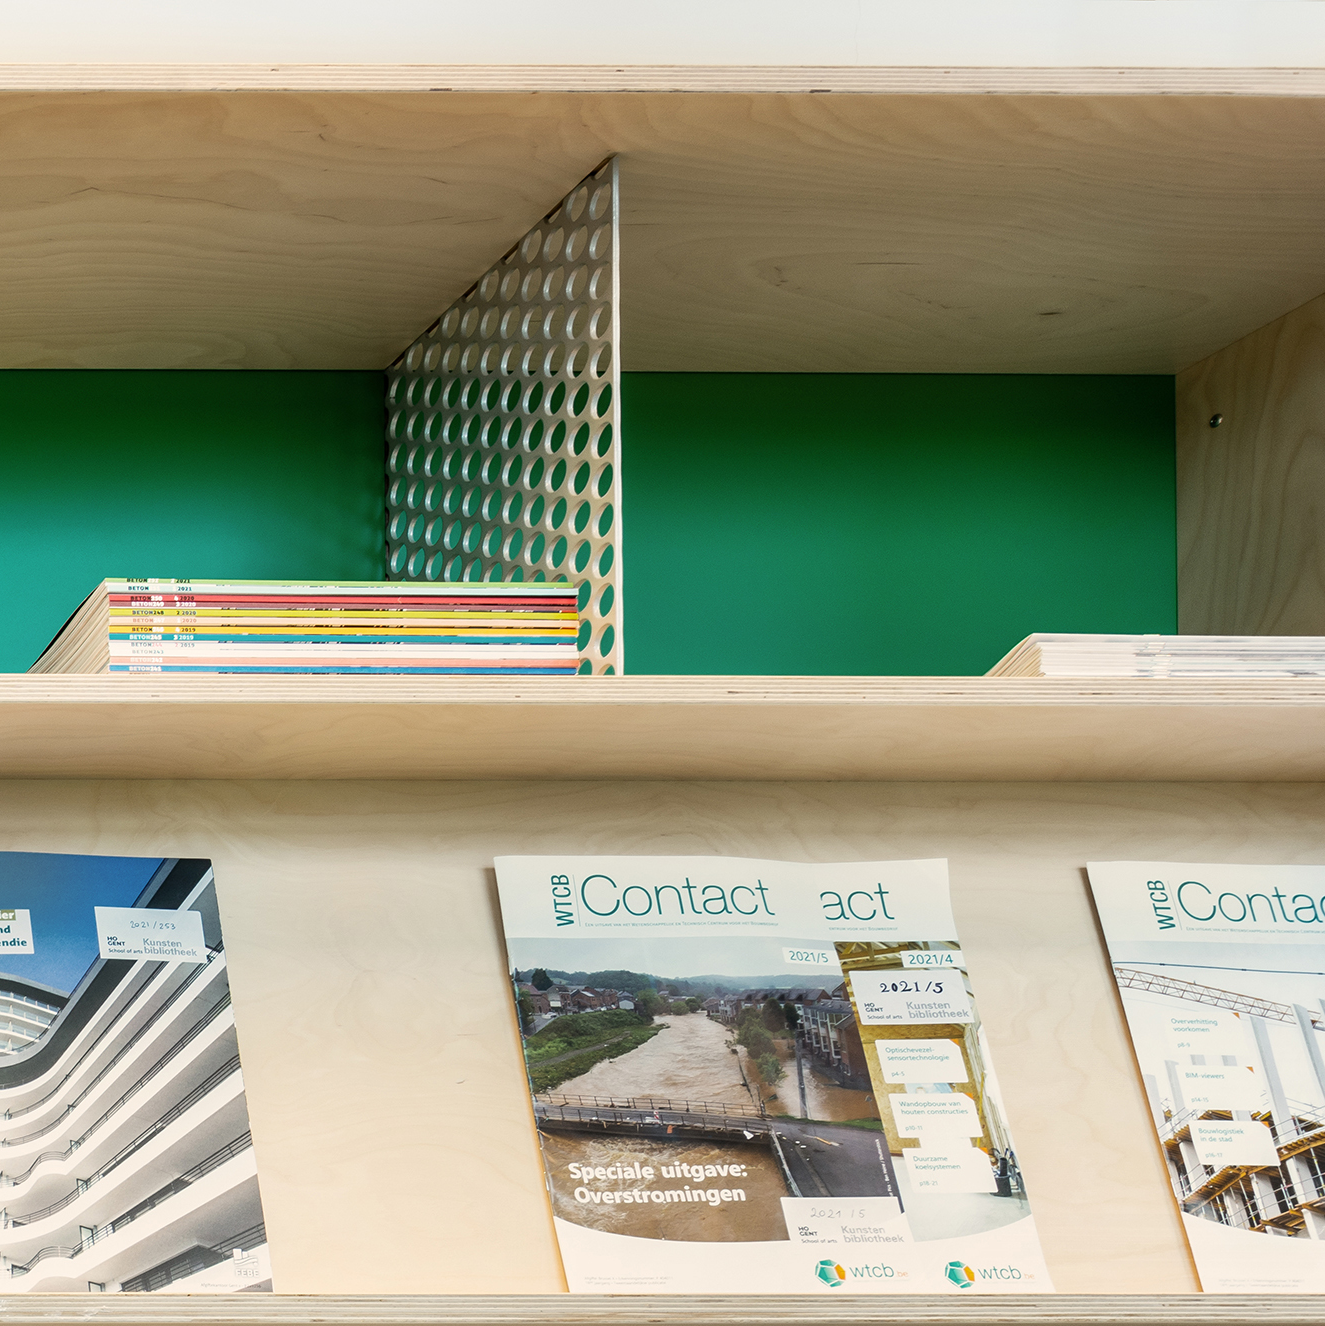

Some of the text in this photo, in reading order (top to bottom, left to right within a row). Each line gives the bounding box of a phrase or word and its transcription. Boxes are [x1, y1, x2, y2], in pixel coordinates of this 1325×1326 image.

[551, 874, 574, 926] WTCB
[581, 874, 775, 916] Contact
[1147, 880, 1176, 930] WTCB
[143, 938, 182, 947] Kunsten
[144, 947, 197, 956] bibliotheek
[789, 951, 829, 963] 2021/5
[908, 965, 953, 1009] 2021/4
[906, 1002, 950, 1010] Kunsten
[908, 1009, 971, 1021] bibliotheek
[1171, 1018, 1218, 1026] Oververhitting
[568, 1161, 748, 1183] Speciale uitgave:
[574, 1185, 746, 1206] Overstromingen
[841, 1226, 885, 1234] Kunsten
[844, 1234, 904, 1242] bibliotheek
[236, 1269, 259, 1277] FEBE
